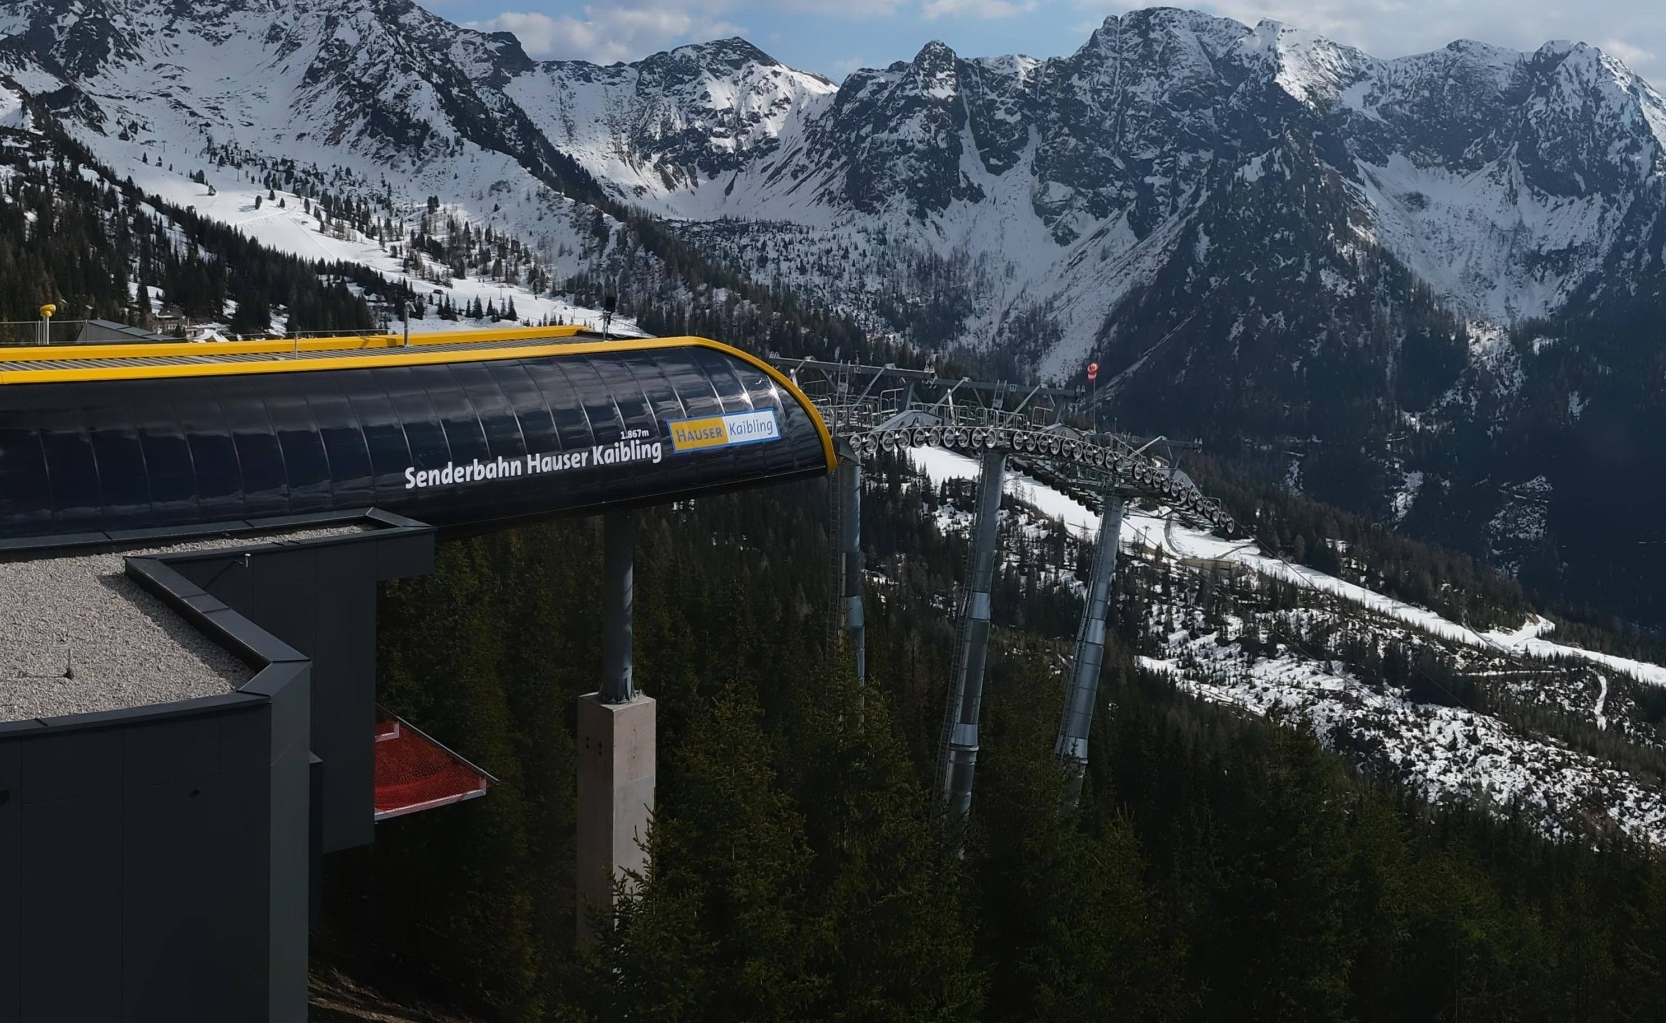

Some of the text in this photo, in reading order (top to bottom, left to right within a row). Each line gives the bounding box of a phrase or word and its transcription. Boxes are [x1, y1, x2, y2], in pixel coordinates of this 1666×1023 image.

[676, 418, 773, 443] HAUSER Kaibling
[405, 439, 662, 489] Senderbahn Hauser Kaibling
